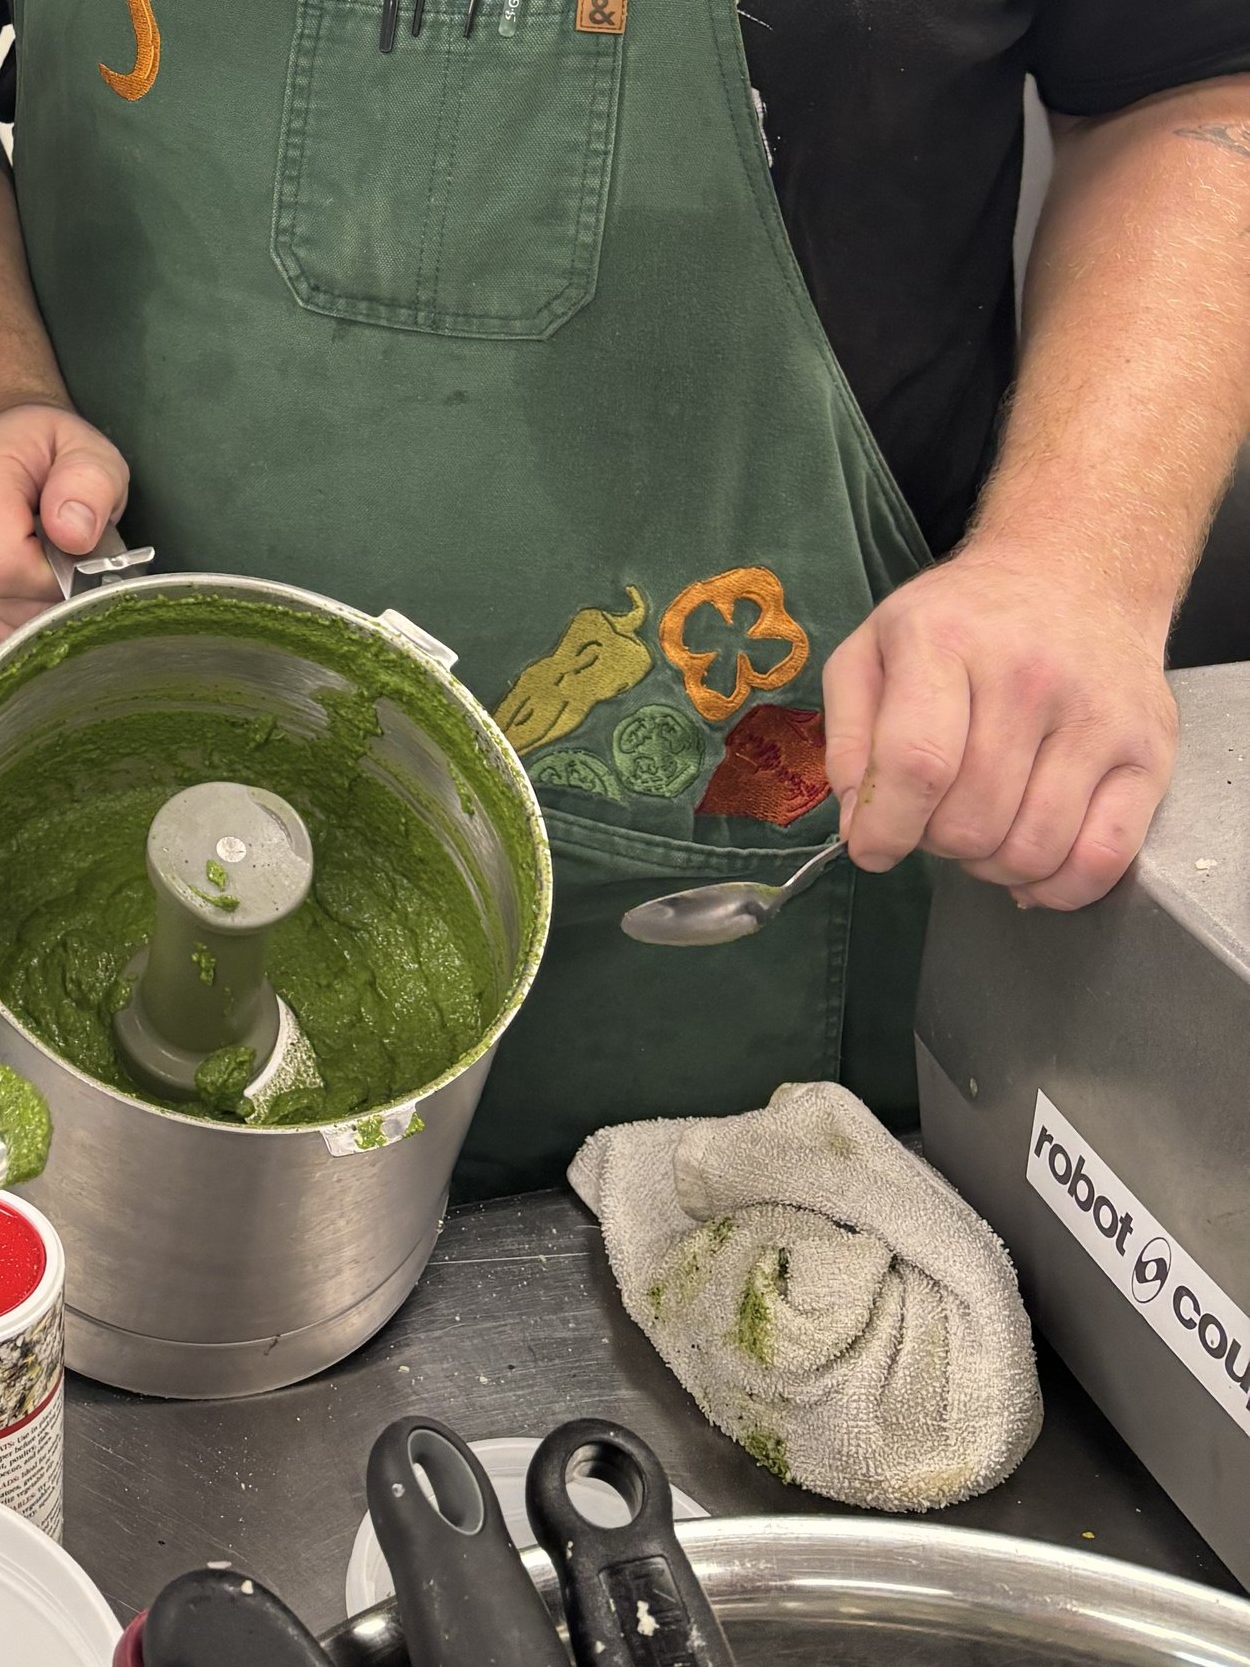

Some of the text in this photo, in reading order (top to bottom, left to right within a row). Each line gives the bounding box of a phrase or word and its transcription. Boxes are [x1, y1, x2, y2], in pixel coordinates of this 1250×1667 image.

[1034, 1124, 1250, 1411] robot cou
[10, 1492, 37, 1512] ABLES:
